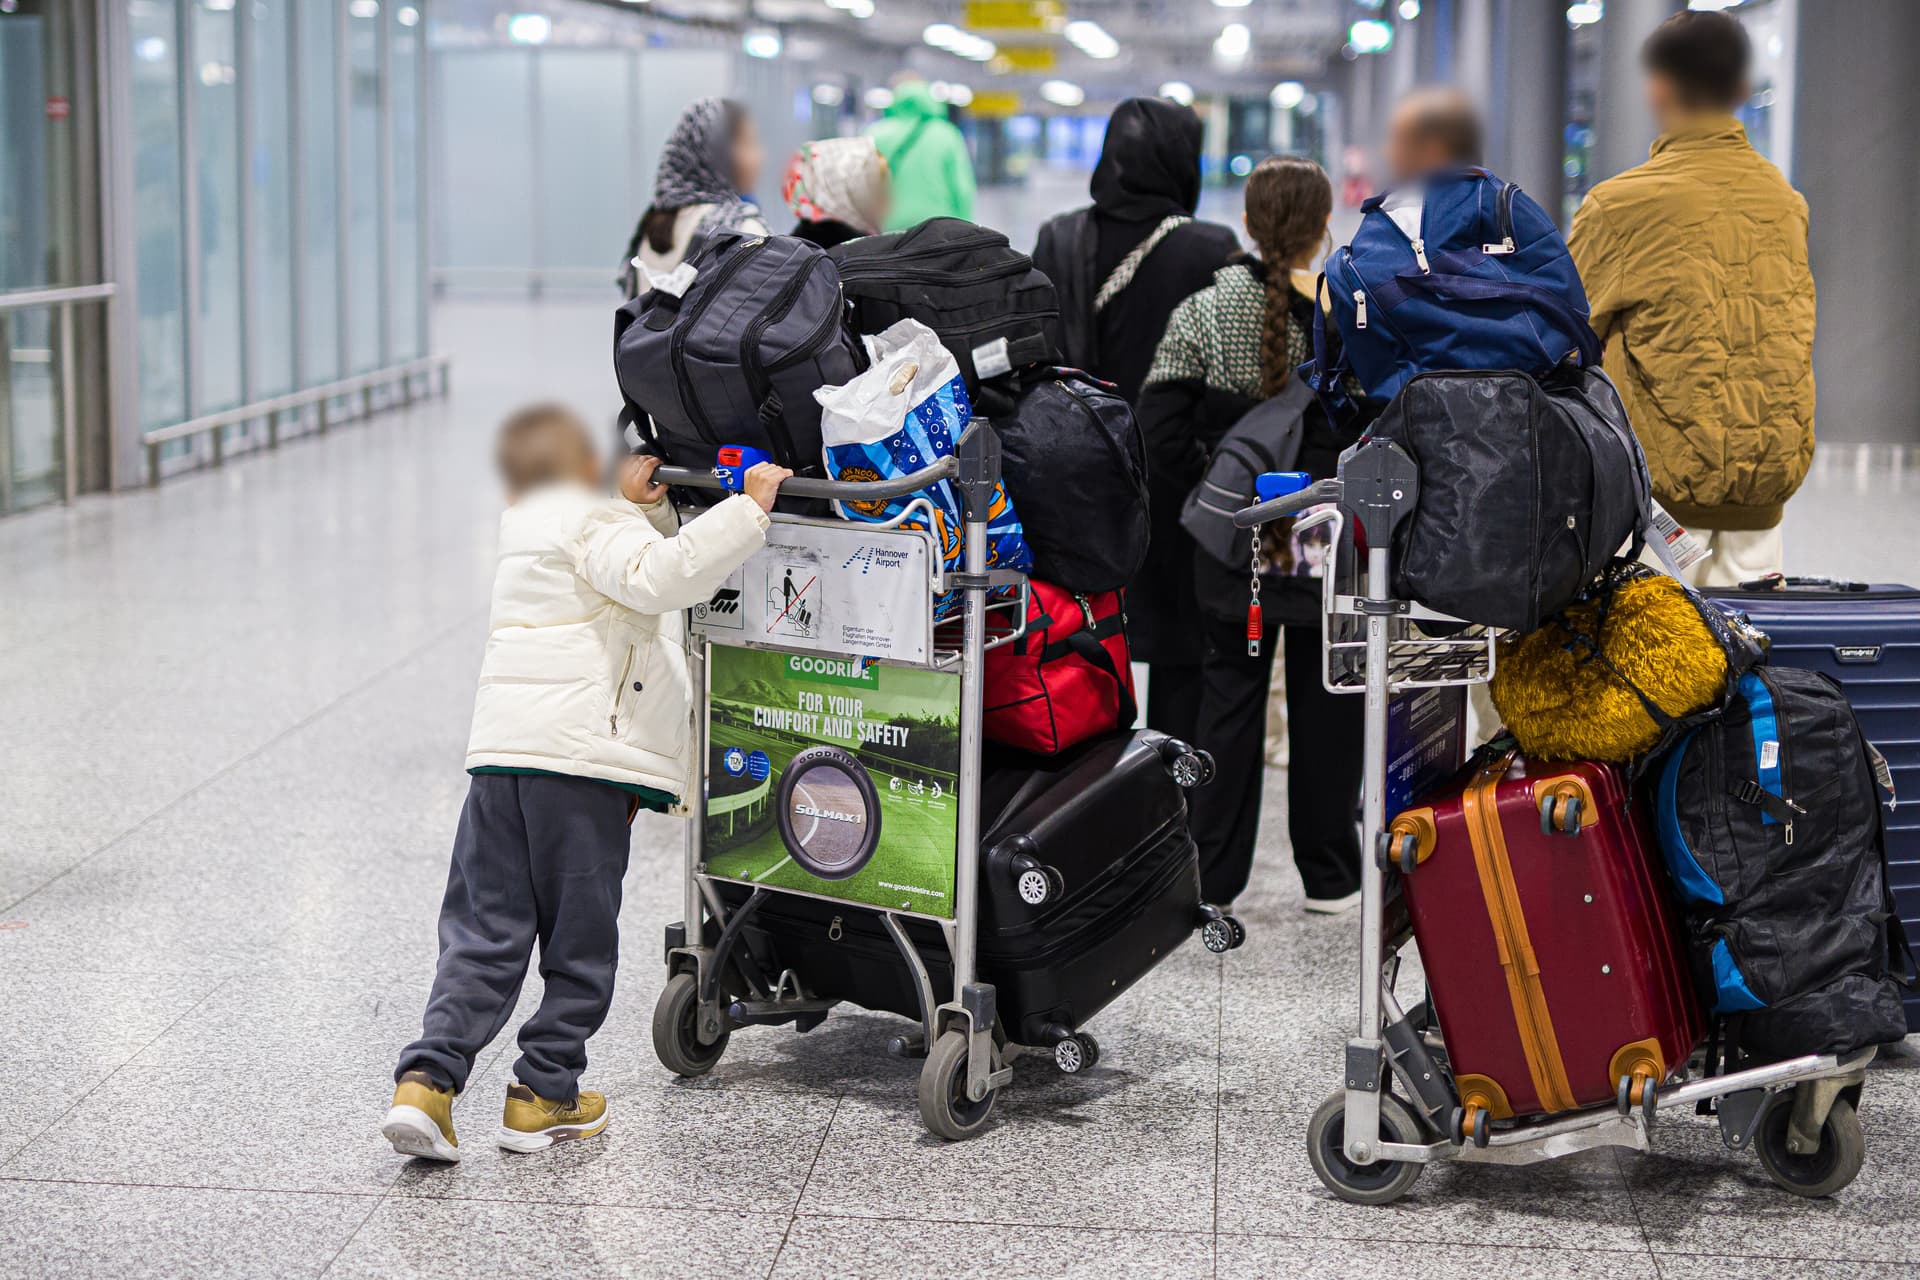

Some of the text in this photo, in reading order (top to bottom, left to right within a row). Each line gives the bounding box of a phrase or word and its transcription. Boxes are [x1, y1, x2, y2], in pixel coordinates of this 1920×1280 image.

[875, 547, 909, 559] Hannover
[875, 557, 900, 569] Airport
[842, 624, 866, 633] Eigentum
[842, 637, 892, 649] Langenhagen GmbH
[798, 690, 863, 719] FOR YOUR
[753, 706, 909, 748] COMFORT AND SAFETY
